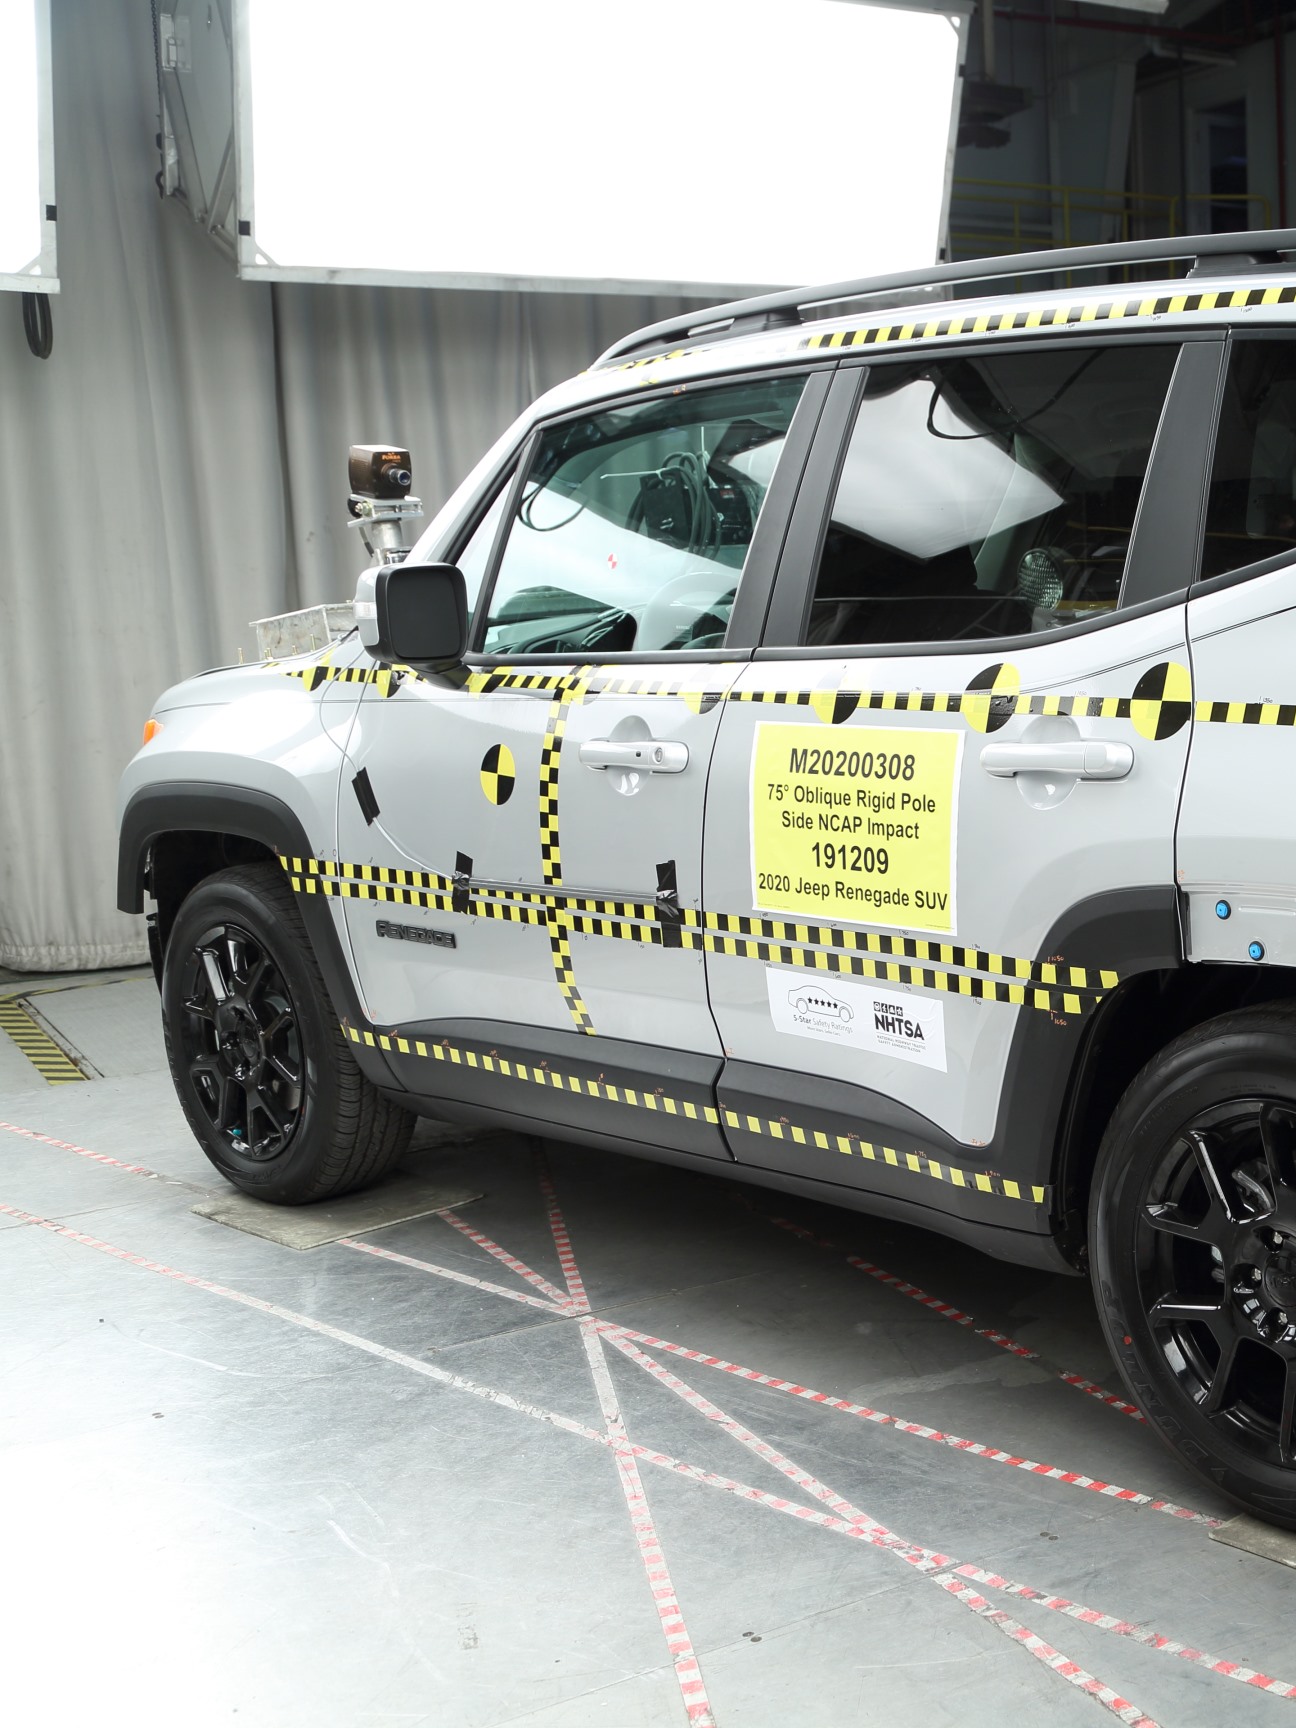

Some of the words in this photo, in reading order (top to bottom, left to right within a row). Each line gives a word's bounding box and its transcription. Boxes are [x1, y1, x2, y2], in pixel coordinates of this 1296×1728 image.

[789, 747, 915, 781] M20200308
[794, 785, 851, 809] Oblique
[856, 789, 896, 813] Rigid
[901, 792, 936, 813] Pole
[781, 810, 814, 829] Side
[819, 813, 863, 834] NCAP
[867, 818, 920, 841] Impact
[812, 841, 889, 875] 191209
[758, 872, 790, 892] 2020
[795, 877, 830, 901] Jeep
[835, 881, 910, 907] Renegade
[914, 890, 948, 911] SUV
[376, 920, 456, 948] RENEGADE
[874, 1013, 925, 1041] NHTSA
